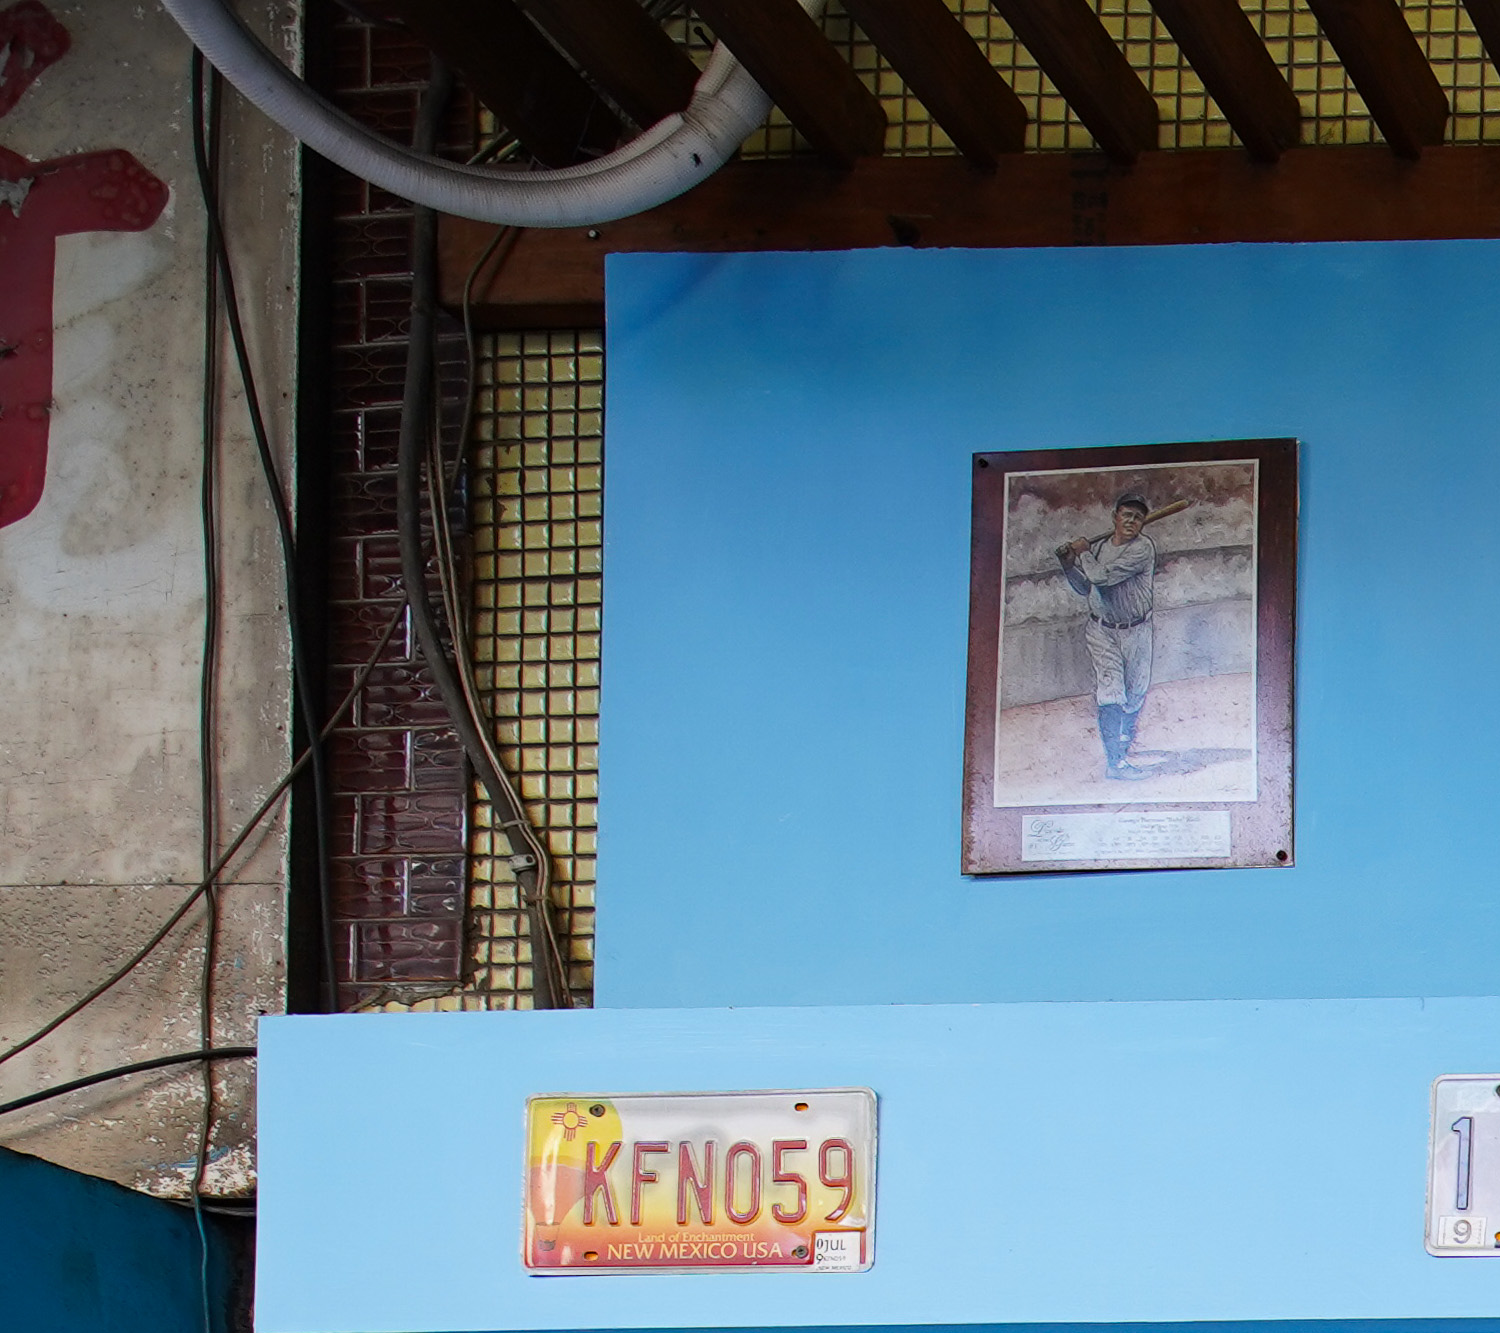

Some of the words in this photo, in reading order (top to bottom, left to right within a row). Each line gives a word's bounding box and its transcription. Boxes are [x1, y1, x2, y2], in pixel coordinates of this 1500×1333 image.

[638, 1231, 663, 1243] Land
[666, 1231, 680, 1243] of
[681, 1231, 755, 1243] Enchantment
[607, 1243, 652, 1261] NEW
[655, 1243, 740, 1260] MEXICO
[743, 1242, 784, 1259] USA
